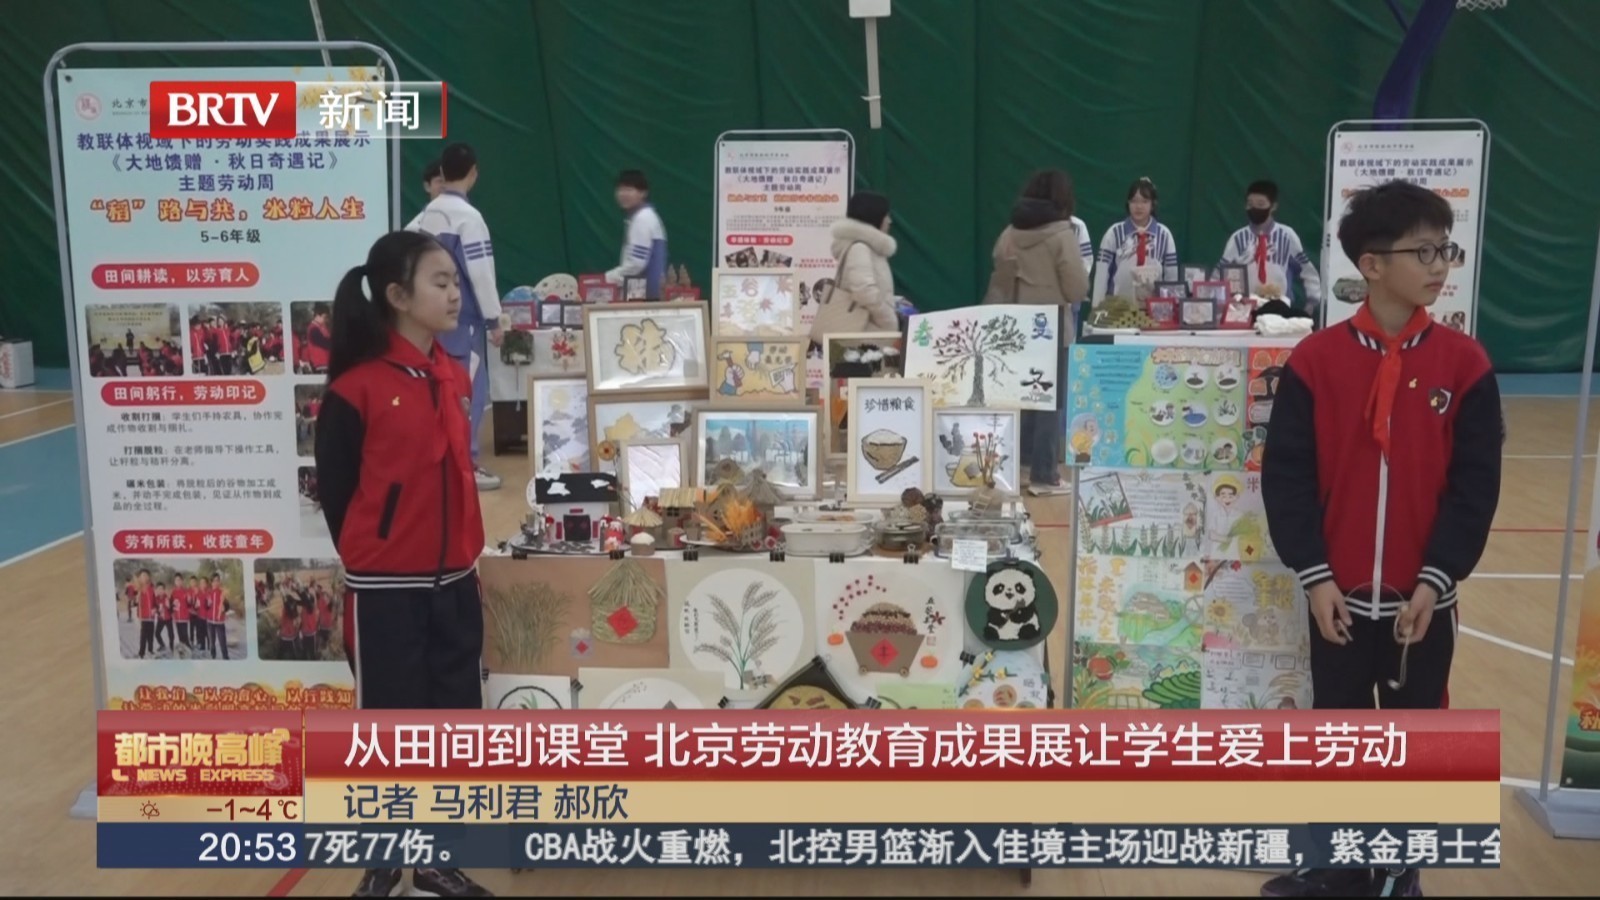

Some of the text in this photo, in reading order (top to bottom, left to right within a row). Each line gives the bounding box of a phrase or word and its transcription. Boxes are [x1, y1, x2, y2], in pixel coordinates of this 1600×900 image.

[178, 174, 275, 192] 主题劳动周
[200, 229, 261, 244] 5-6年级
[104, 267, 250, 284] 田间耕读，以劳育人
[912, 318, 933, 347] 春
[1031, 312, 1053, 340] 夏
[114, 385, 257, 401] 田间躬行，劳动印记
[865, 396, 915, 413] 珍惜粮食
[125, 533, 265, 550] 劳有所获，收获童年
